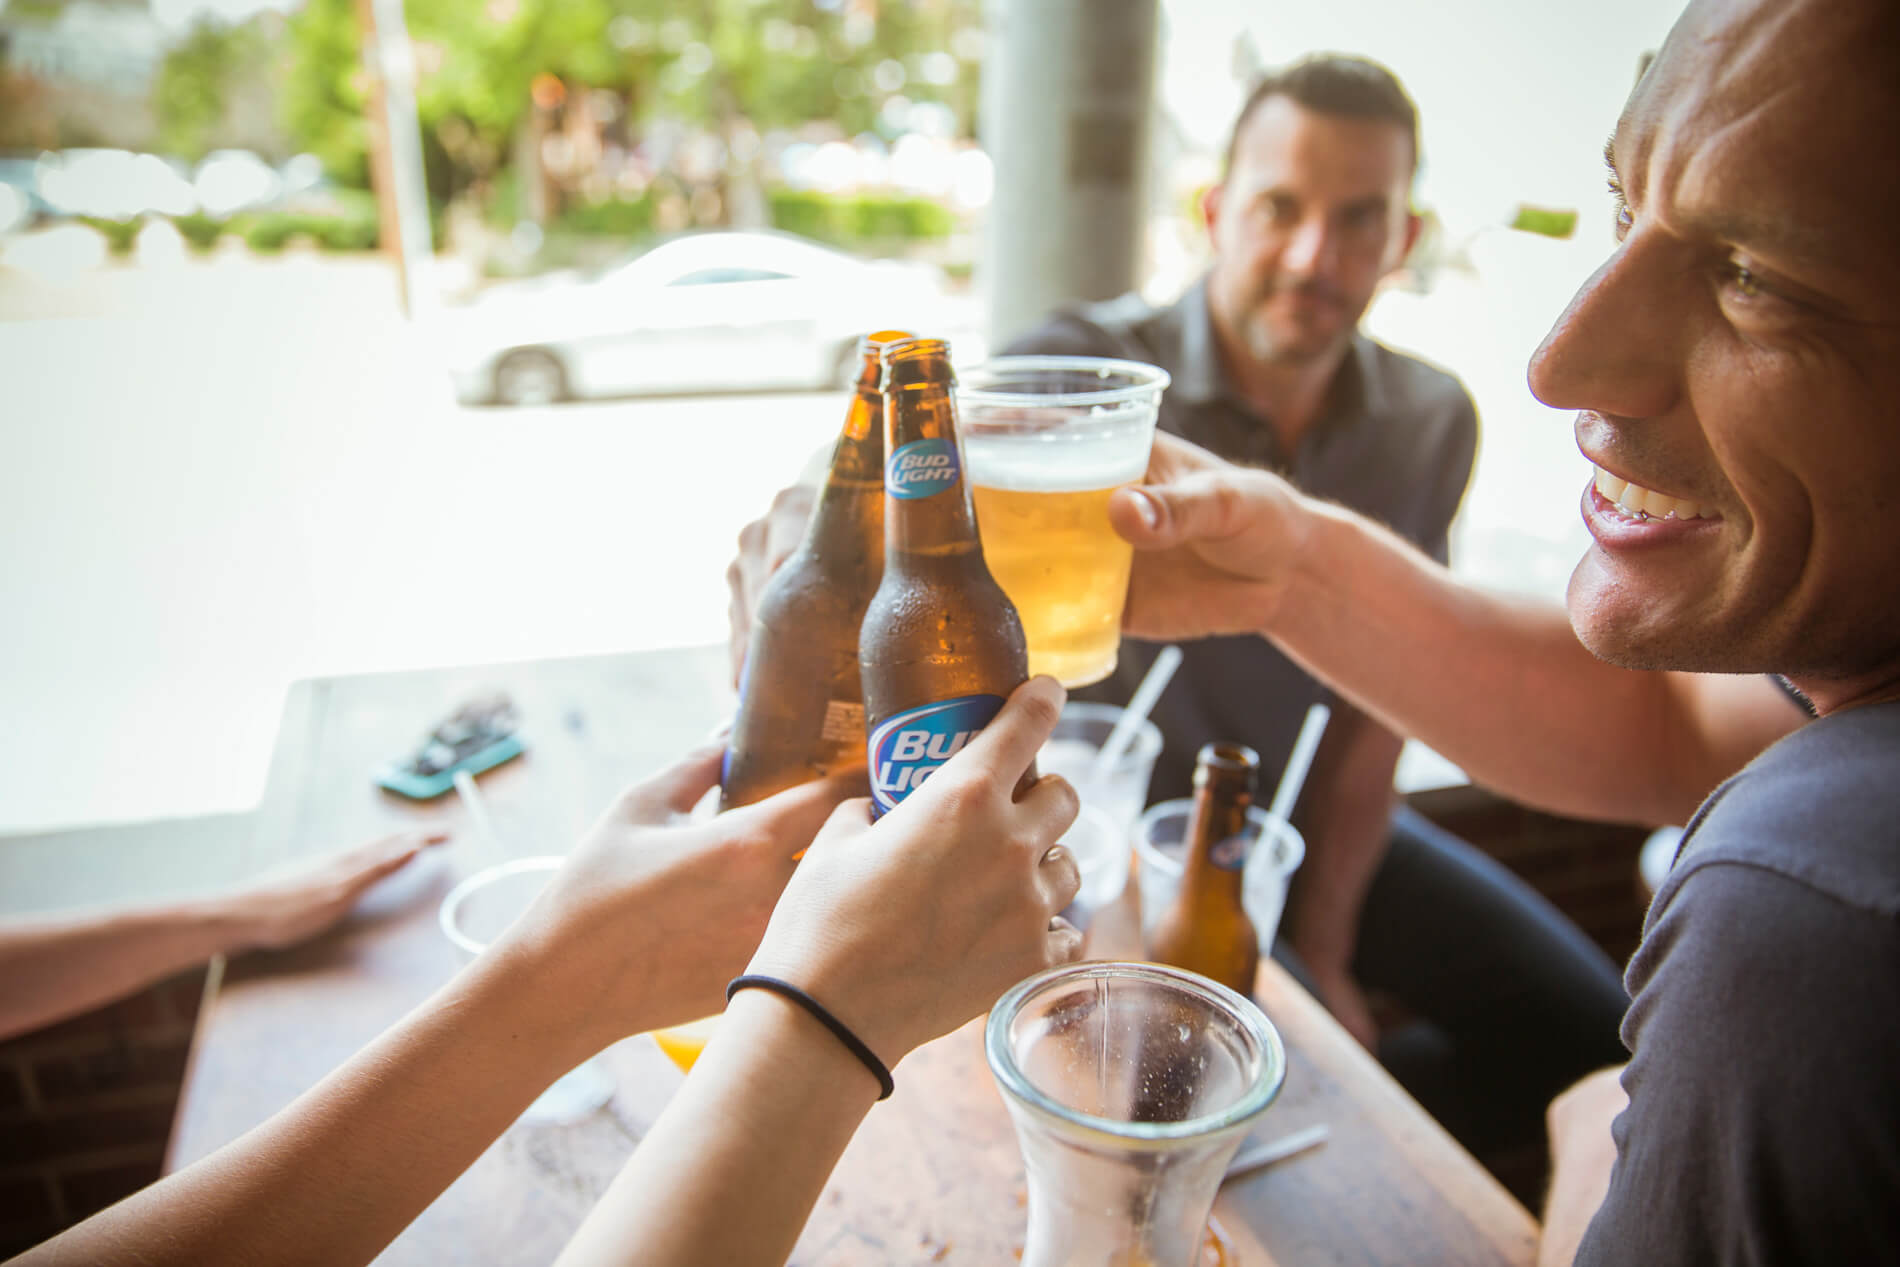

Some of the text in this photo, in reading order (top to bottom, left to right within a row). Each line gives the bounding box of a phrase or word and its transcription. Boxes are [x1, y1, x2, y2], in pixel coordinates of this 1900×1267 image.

[900, 454, 950, 470] BUD
[895, 467, 957, 486] LIGHT
[891, 730, 983, 761] BU
